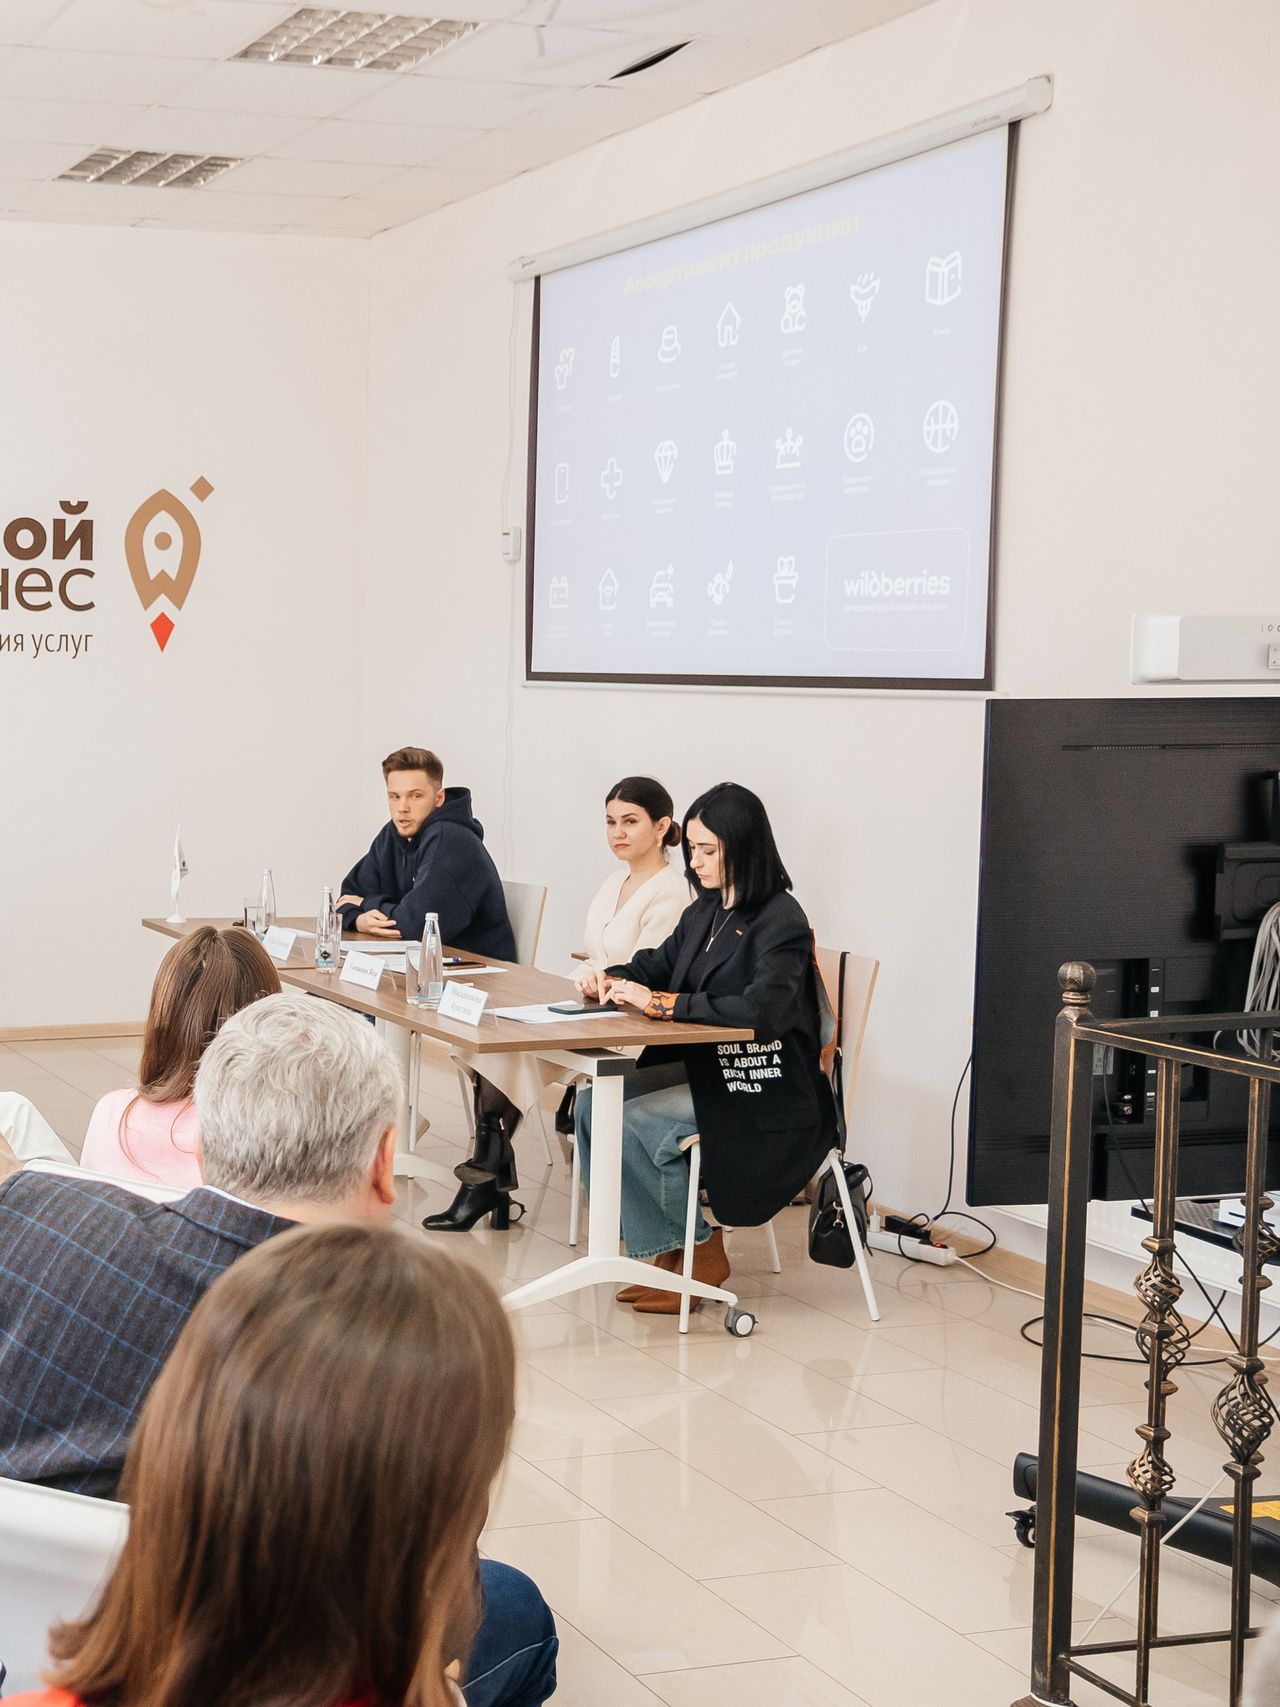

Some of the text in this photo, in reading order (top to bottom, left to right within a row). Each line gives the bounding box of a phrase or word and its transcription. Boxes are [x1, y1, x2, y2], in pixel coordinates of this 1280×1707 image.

[622, 213, 860, 296] Ассортимент продукции
[844, 568, 951, 597] wildberries
[31, 632, 94, 659] услуг
[717, 1039, 782, 1055] SOUL BRAND
[719, 1053, 782, 1068] IS ABOUT A
[722, 1067, 782, 1080] RICH INNER
[726, 1080, 762, 1093] WORLD
